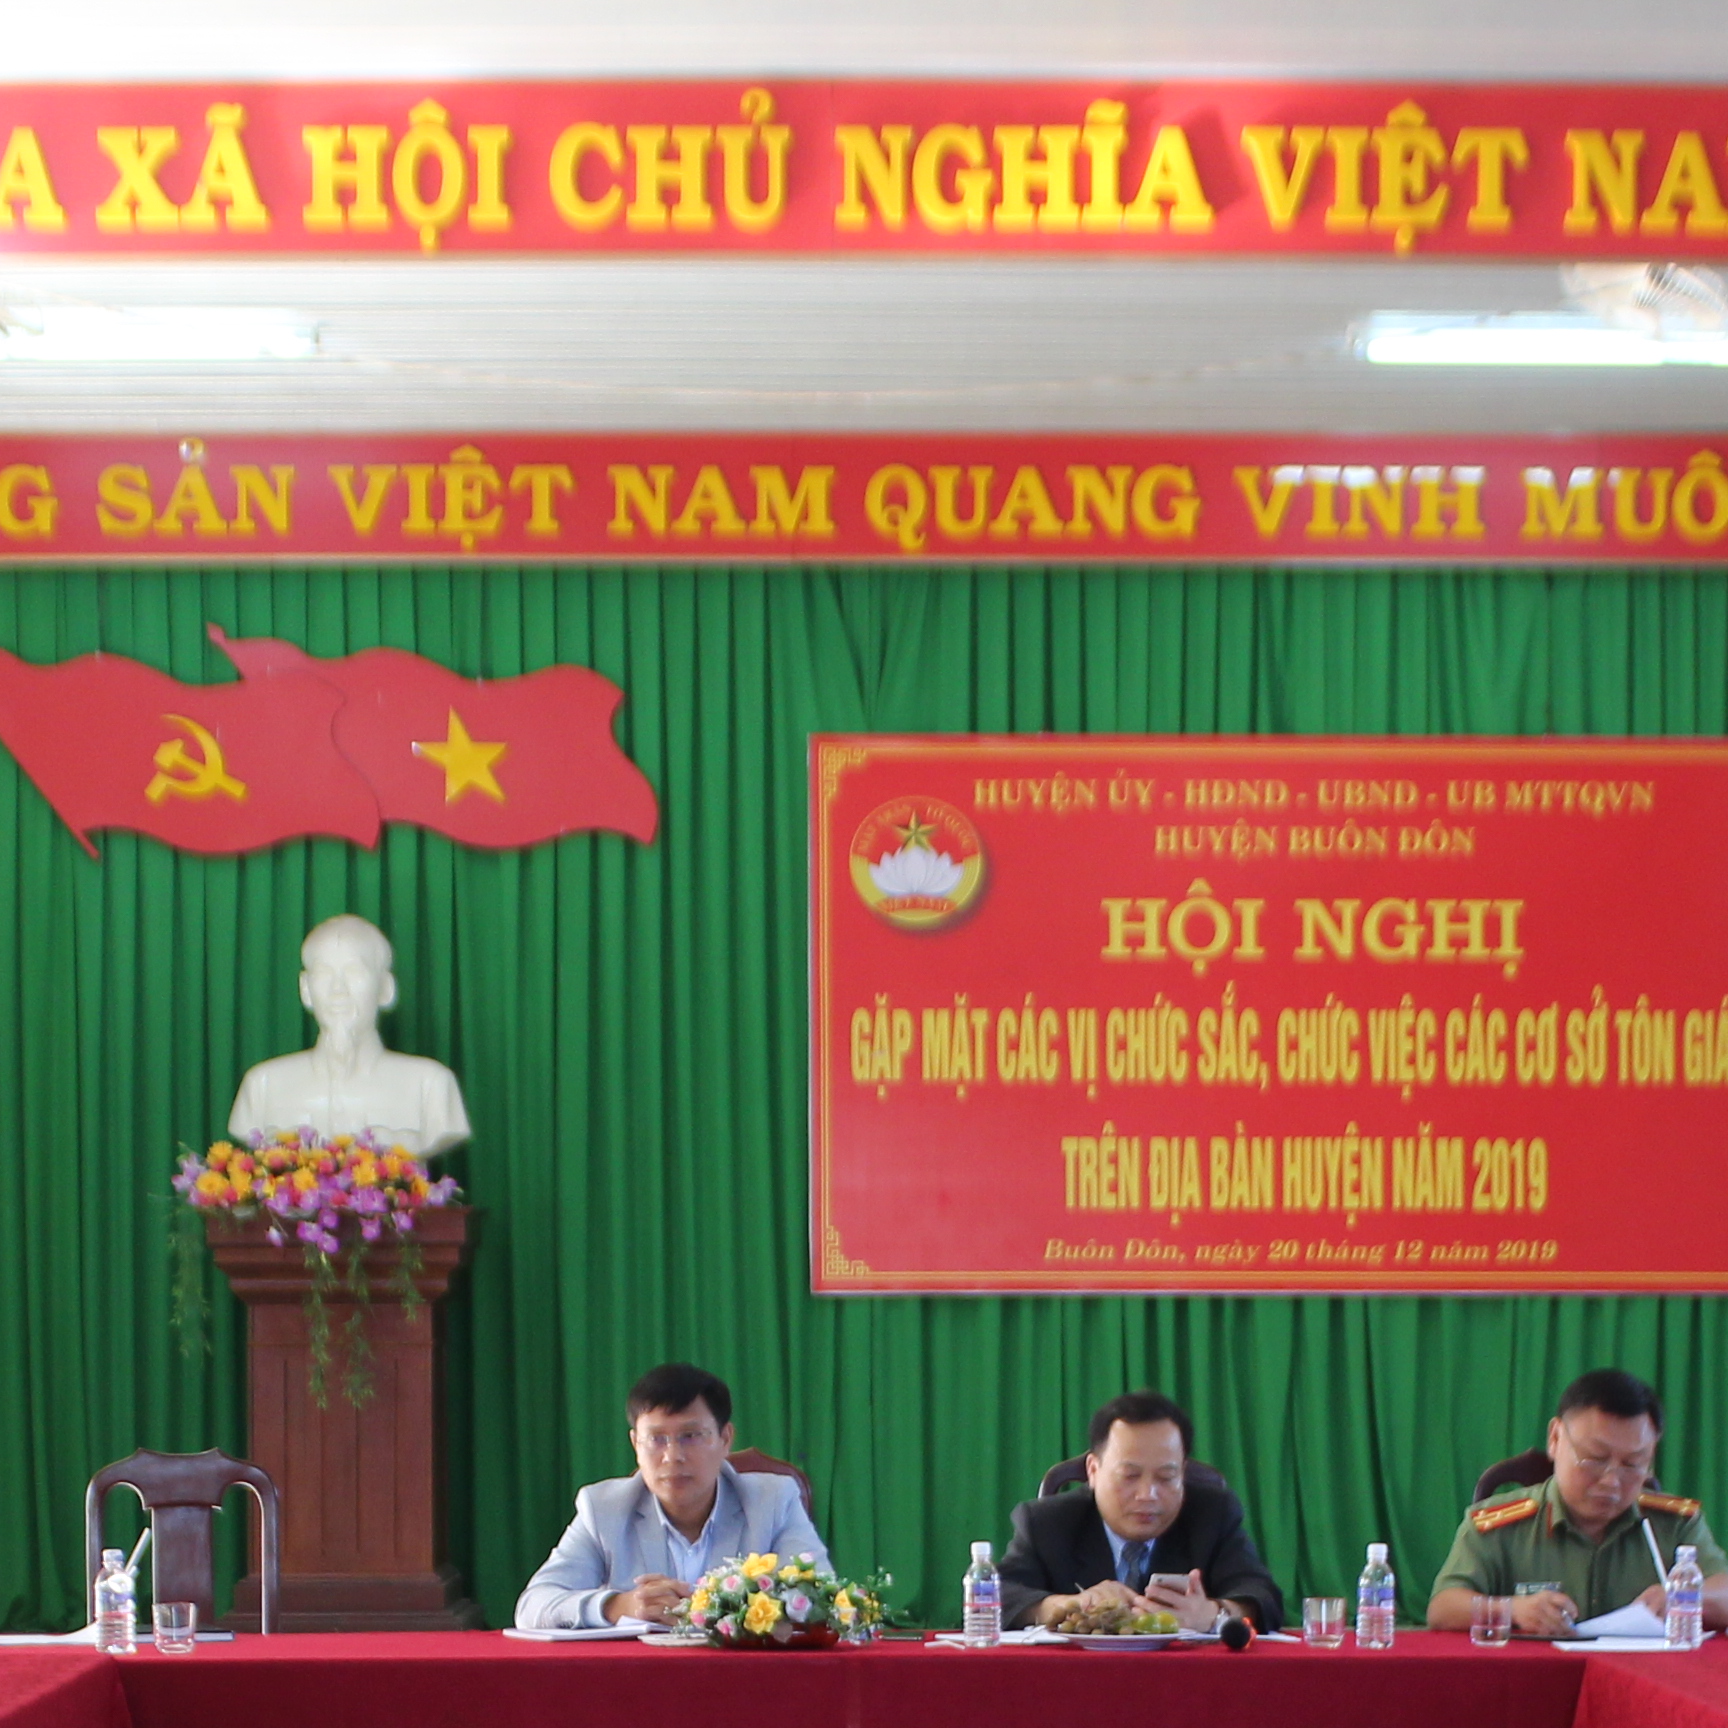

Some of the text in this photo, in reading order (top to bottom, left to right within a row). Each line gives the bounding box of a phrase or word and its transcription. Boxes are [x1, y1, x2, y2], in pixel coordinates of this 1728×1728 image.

[96, 101, 269, 234] XÃ
[302, 98, 511, 254] HỘI
[548, 87, 790, 234] CHỦ
[834, 97, 1216, 233] NGHĨA
[1241, 99, 1528, 255] VIỆT
[95, 437, 295, 540] SẢN
[328, 443, 574, 553] VIỆT
[606, 463, 836, 540] NAM
[864, 463, 1202, 552] QUANG
[1233, 465, 1486, 541] VINH
[973, 771, 1098, 815] HUYỆN
[1316, 779, 1420, 811] UBND
[1446, 779, 1497, 811] UB
[1154, 817, 1279, 864] HUYỆN
[1289, 818, 1388, 859] BUÔN
[1099, 877, 1525, 979] HỘI NGHỊ
[850, 991, 913, 1099] GẶP
[921, 991, 989, 1099] MẶT
[996, 991, 1059, 1084] CÁC
[1067, 1006, 1098, 1099] VỊ
[1105, 991, 1189, 1084] CHỨC
[1197, 980, 1269, 1093] SẮC,
[1277, 991, 1360, 1085] CHỨC
[1368, 992, 1437, 1102] VIỆC
[1445, 992, 1509, 1085] CÁC
[1515, 1000, 1559, 1085] CƠ
[1566, 984, 1609, 1085] SỞ
[1614, 993, 1676, 1087] TÔN
[1061, 1119, 1549, 1229] TRÊN ĐỊA BÀN HUYỆN NĂM 2019
[1043, 1238, 1115, 1261] Buôn
[1194, 1239, 1261, 1264] ngày
[1267, 1238, 1299, 1260] 20
[1305, 1239, 1385, 1265] tháng
[1394, 1239, 1424, 1261] 12
[1430, 1240, 1489, 1261] năm
[1496, 1239, 1559, 1262] 2019
